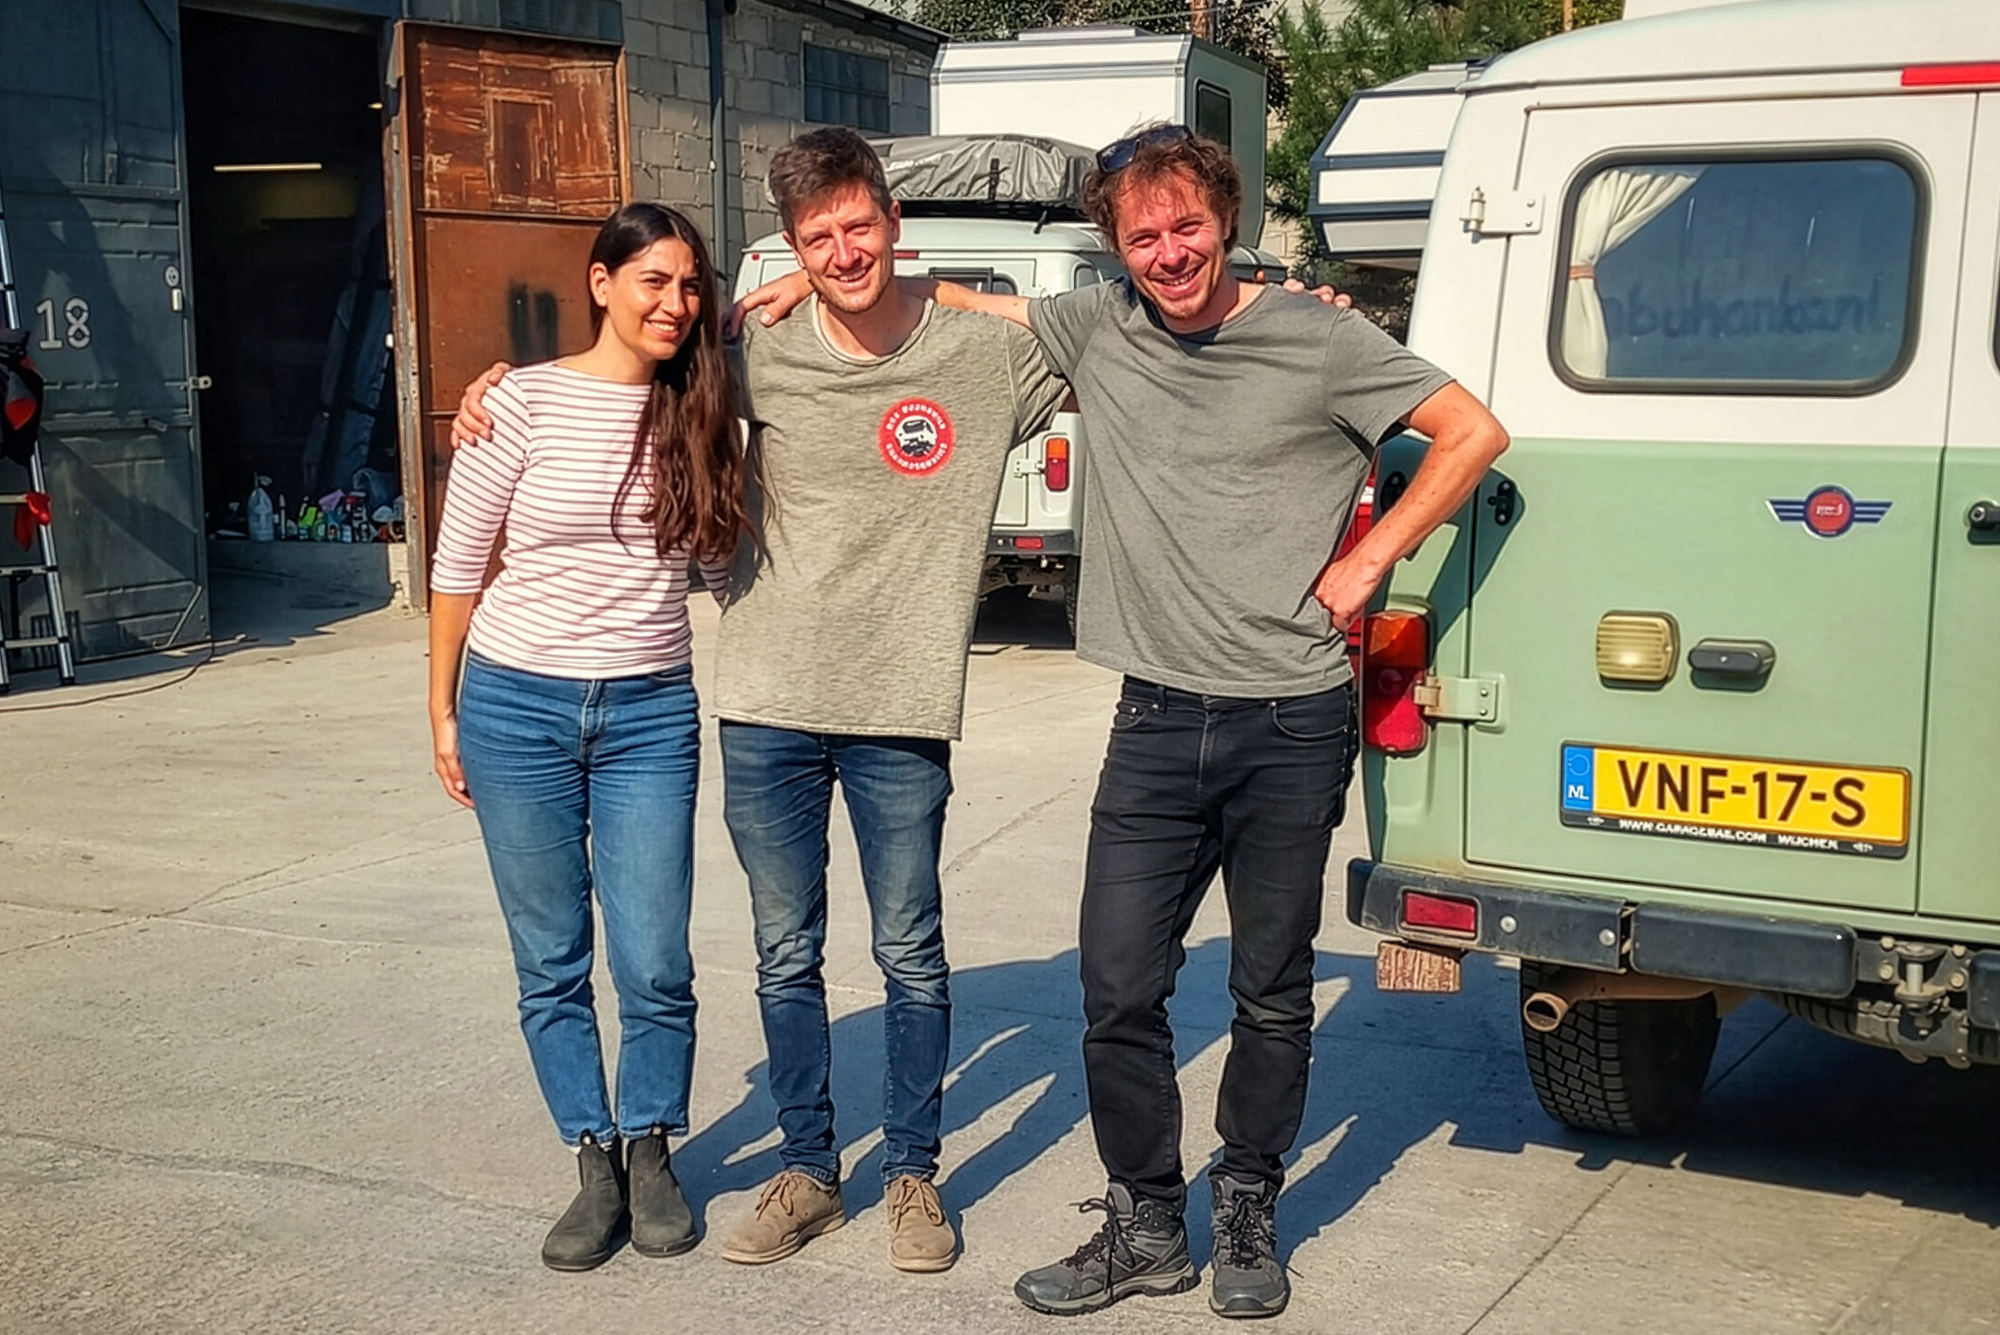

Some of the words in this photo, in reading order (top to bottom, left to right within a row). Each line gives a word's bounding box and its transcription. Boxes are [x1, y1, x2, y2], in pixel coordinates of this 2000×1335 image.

[36, 298, 90, 349] 18
[1568, 784, 1589, 801] NL
[1617, 760, 1866, 827] VNF-17-S
